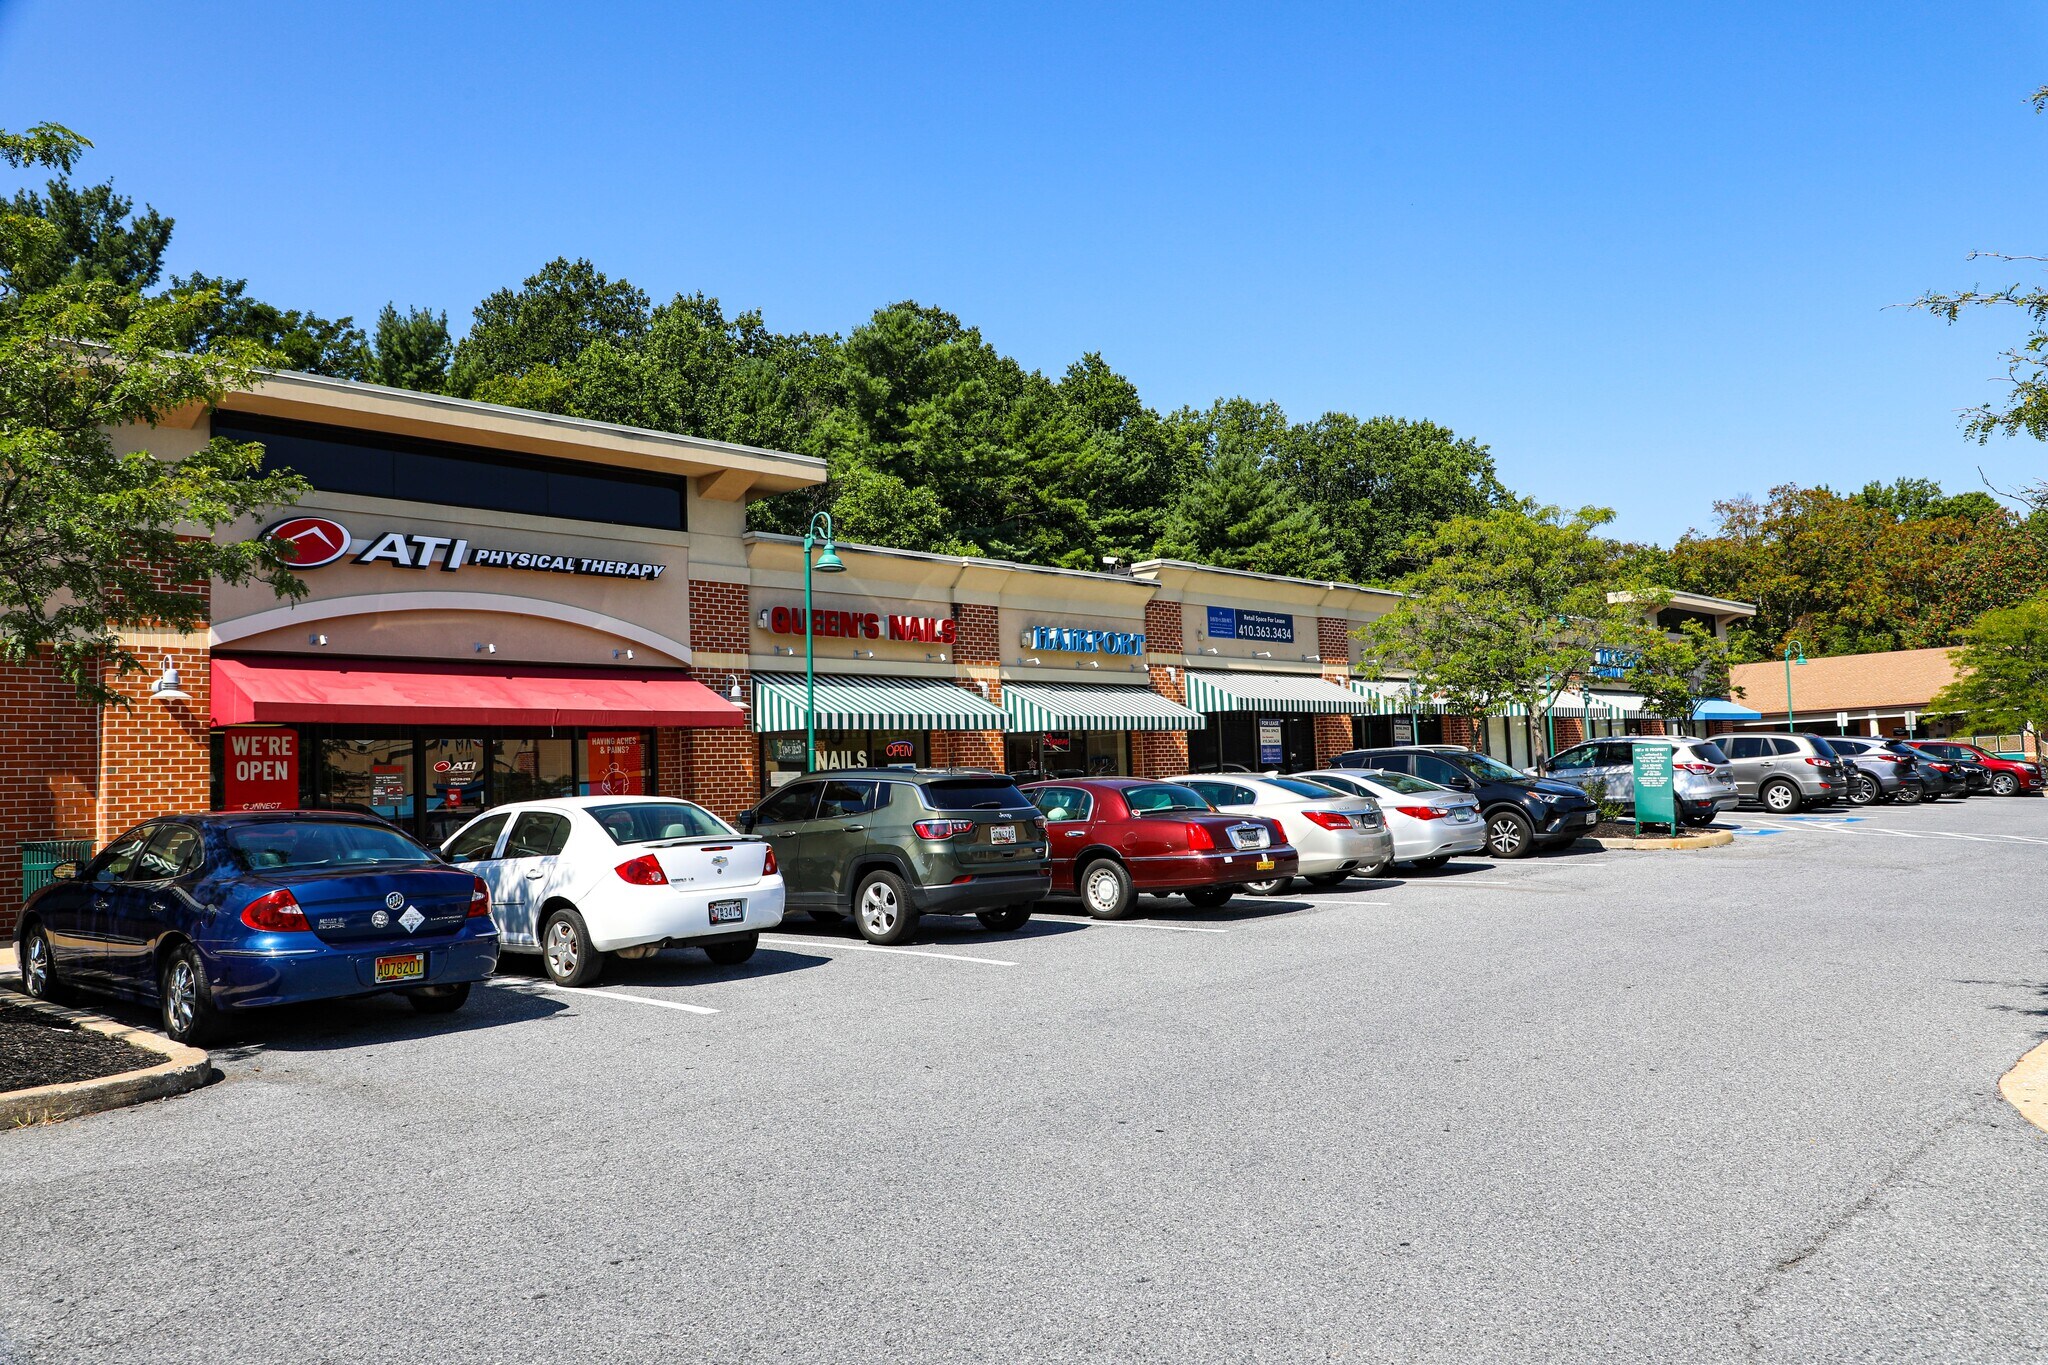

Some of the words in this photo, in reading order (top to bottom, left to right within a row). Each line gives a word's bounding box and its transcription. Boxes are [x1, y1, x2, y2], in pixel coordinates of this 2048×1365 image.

[354, 532, 468, 570] ATI
[471, 549, 576, 571] PHYSICAL
[581, 558, 667, 579] THERAPY
[770, 606, 880, 640] QUEEN'S
[884, 614, 956, 645] NAILS
[1255, 615, 1267, 623] Space
[1031, 625, 1146, 656] HAIRPORT
[1238, 624, 1292, 640] 410.363.3434
[231, 736, 293, 756] WE'RE
[592, 737, 615, 745] HAVING
[616, 736, 637, 745] ACHES
[600, 746, 605, 754] &
[607, 746, 630, 754] PAINS?
[885, 744, 912, 757] OPEN
[236, 760, 288, 781] OPEN
[450, 761, 477, 771] ATI
[815, 750, 868, 771] NAILS
